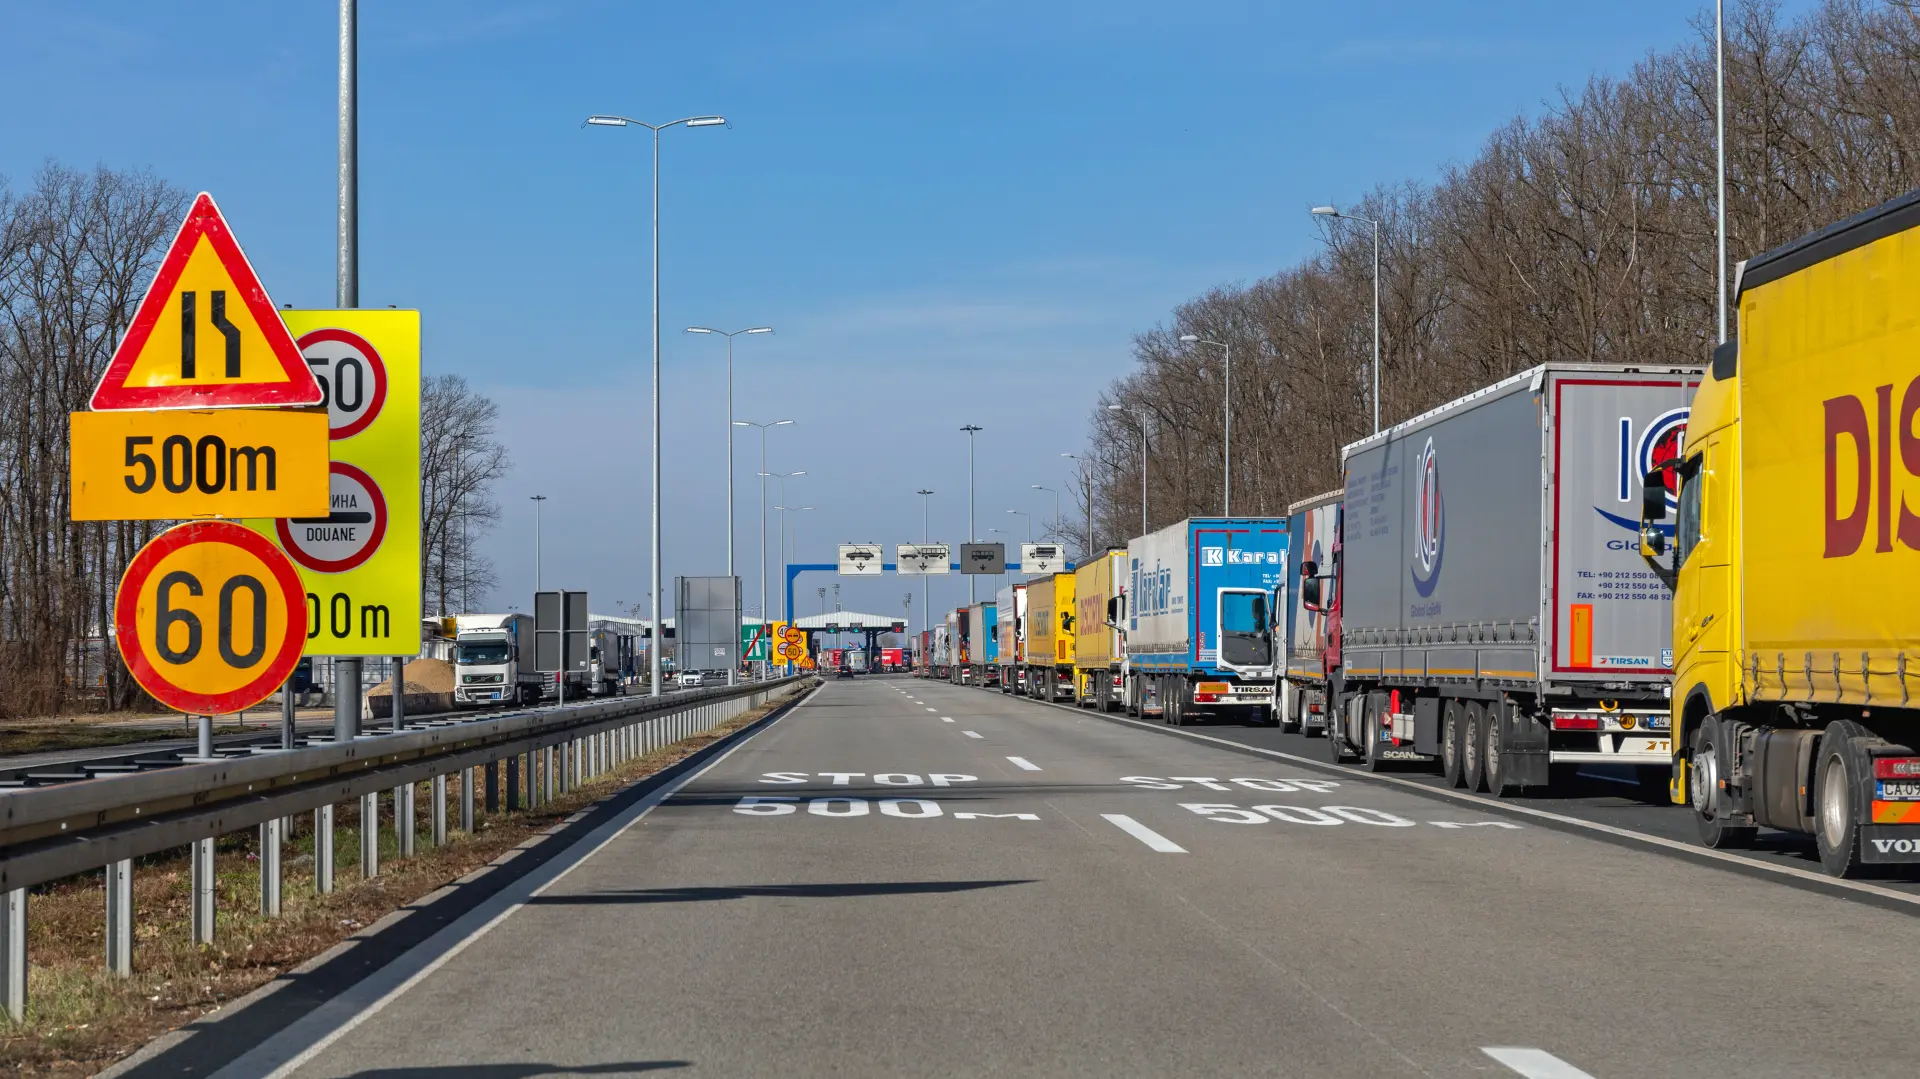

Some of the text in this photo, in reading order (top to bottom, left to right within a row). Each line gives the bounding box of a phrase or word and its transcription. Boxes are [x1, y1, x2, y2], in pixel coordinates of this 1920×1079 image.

[124, 434, 276, 494] 500m
[330, 494, 358, 508] ИНА
[307, 527, 356, 541] DOUANE
[1598, 592, 1613, 600] +90
[1614, 592, 1630, 600] 212
[155, 570, 267, 669] 60
[787, 647, 797, 656] 50
[1609, 656, 1649, 665] TIRSAN
[1654, 716, 1665, 726] 34
[758, 772, 978, 787] STOP
[1119, 776, 1341, 793] STOP
[1884, 783, 1902, 796] CA
